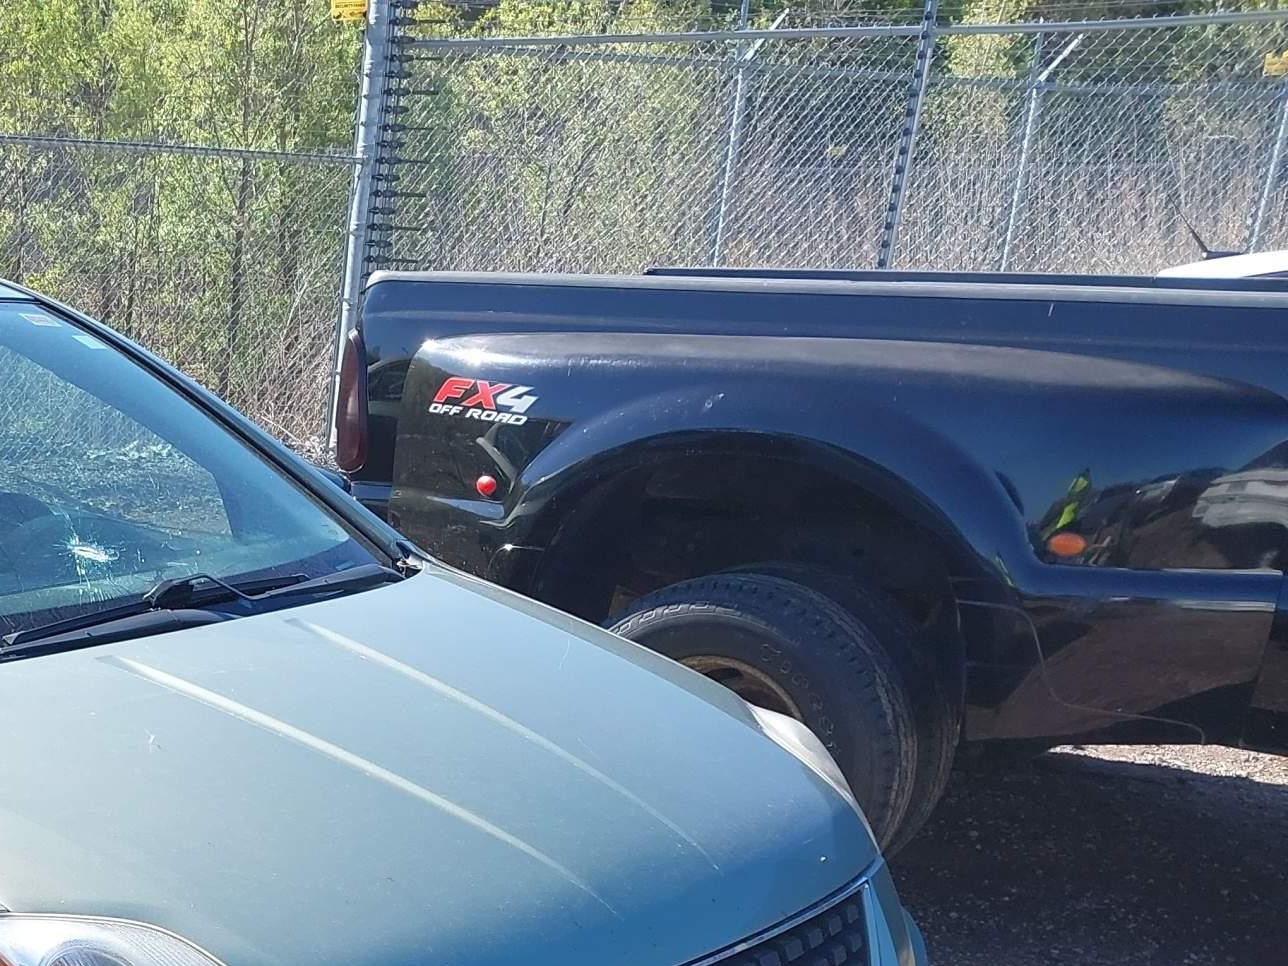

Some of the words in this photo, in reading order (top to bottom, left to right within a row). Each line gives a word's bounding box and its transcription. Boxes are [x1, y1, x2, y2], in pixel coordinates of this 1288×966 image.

[433, 376, 540, 414] FX4
[428, 403, 464, 416] OFF
[465, 408, 528, 426] ROAD
